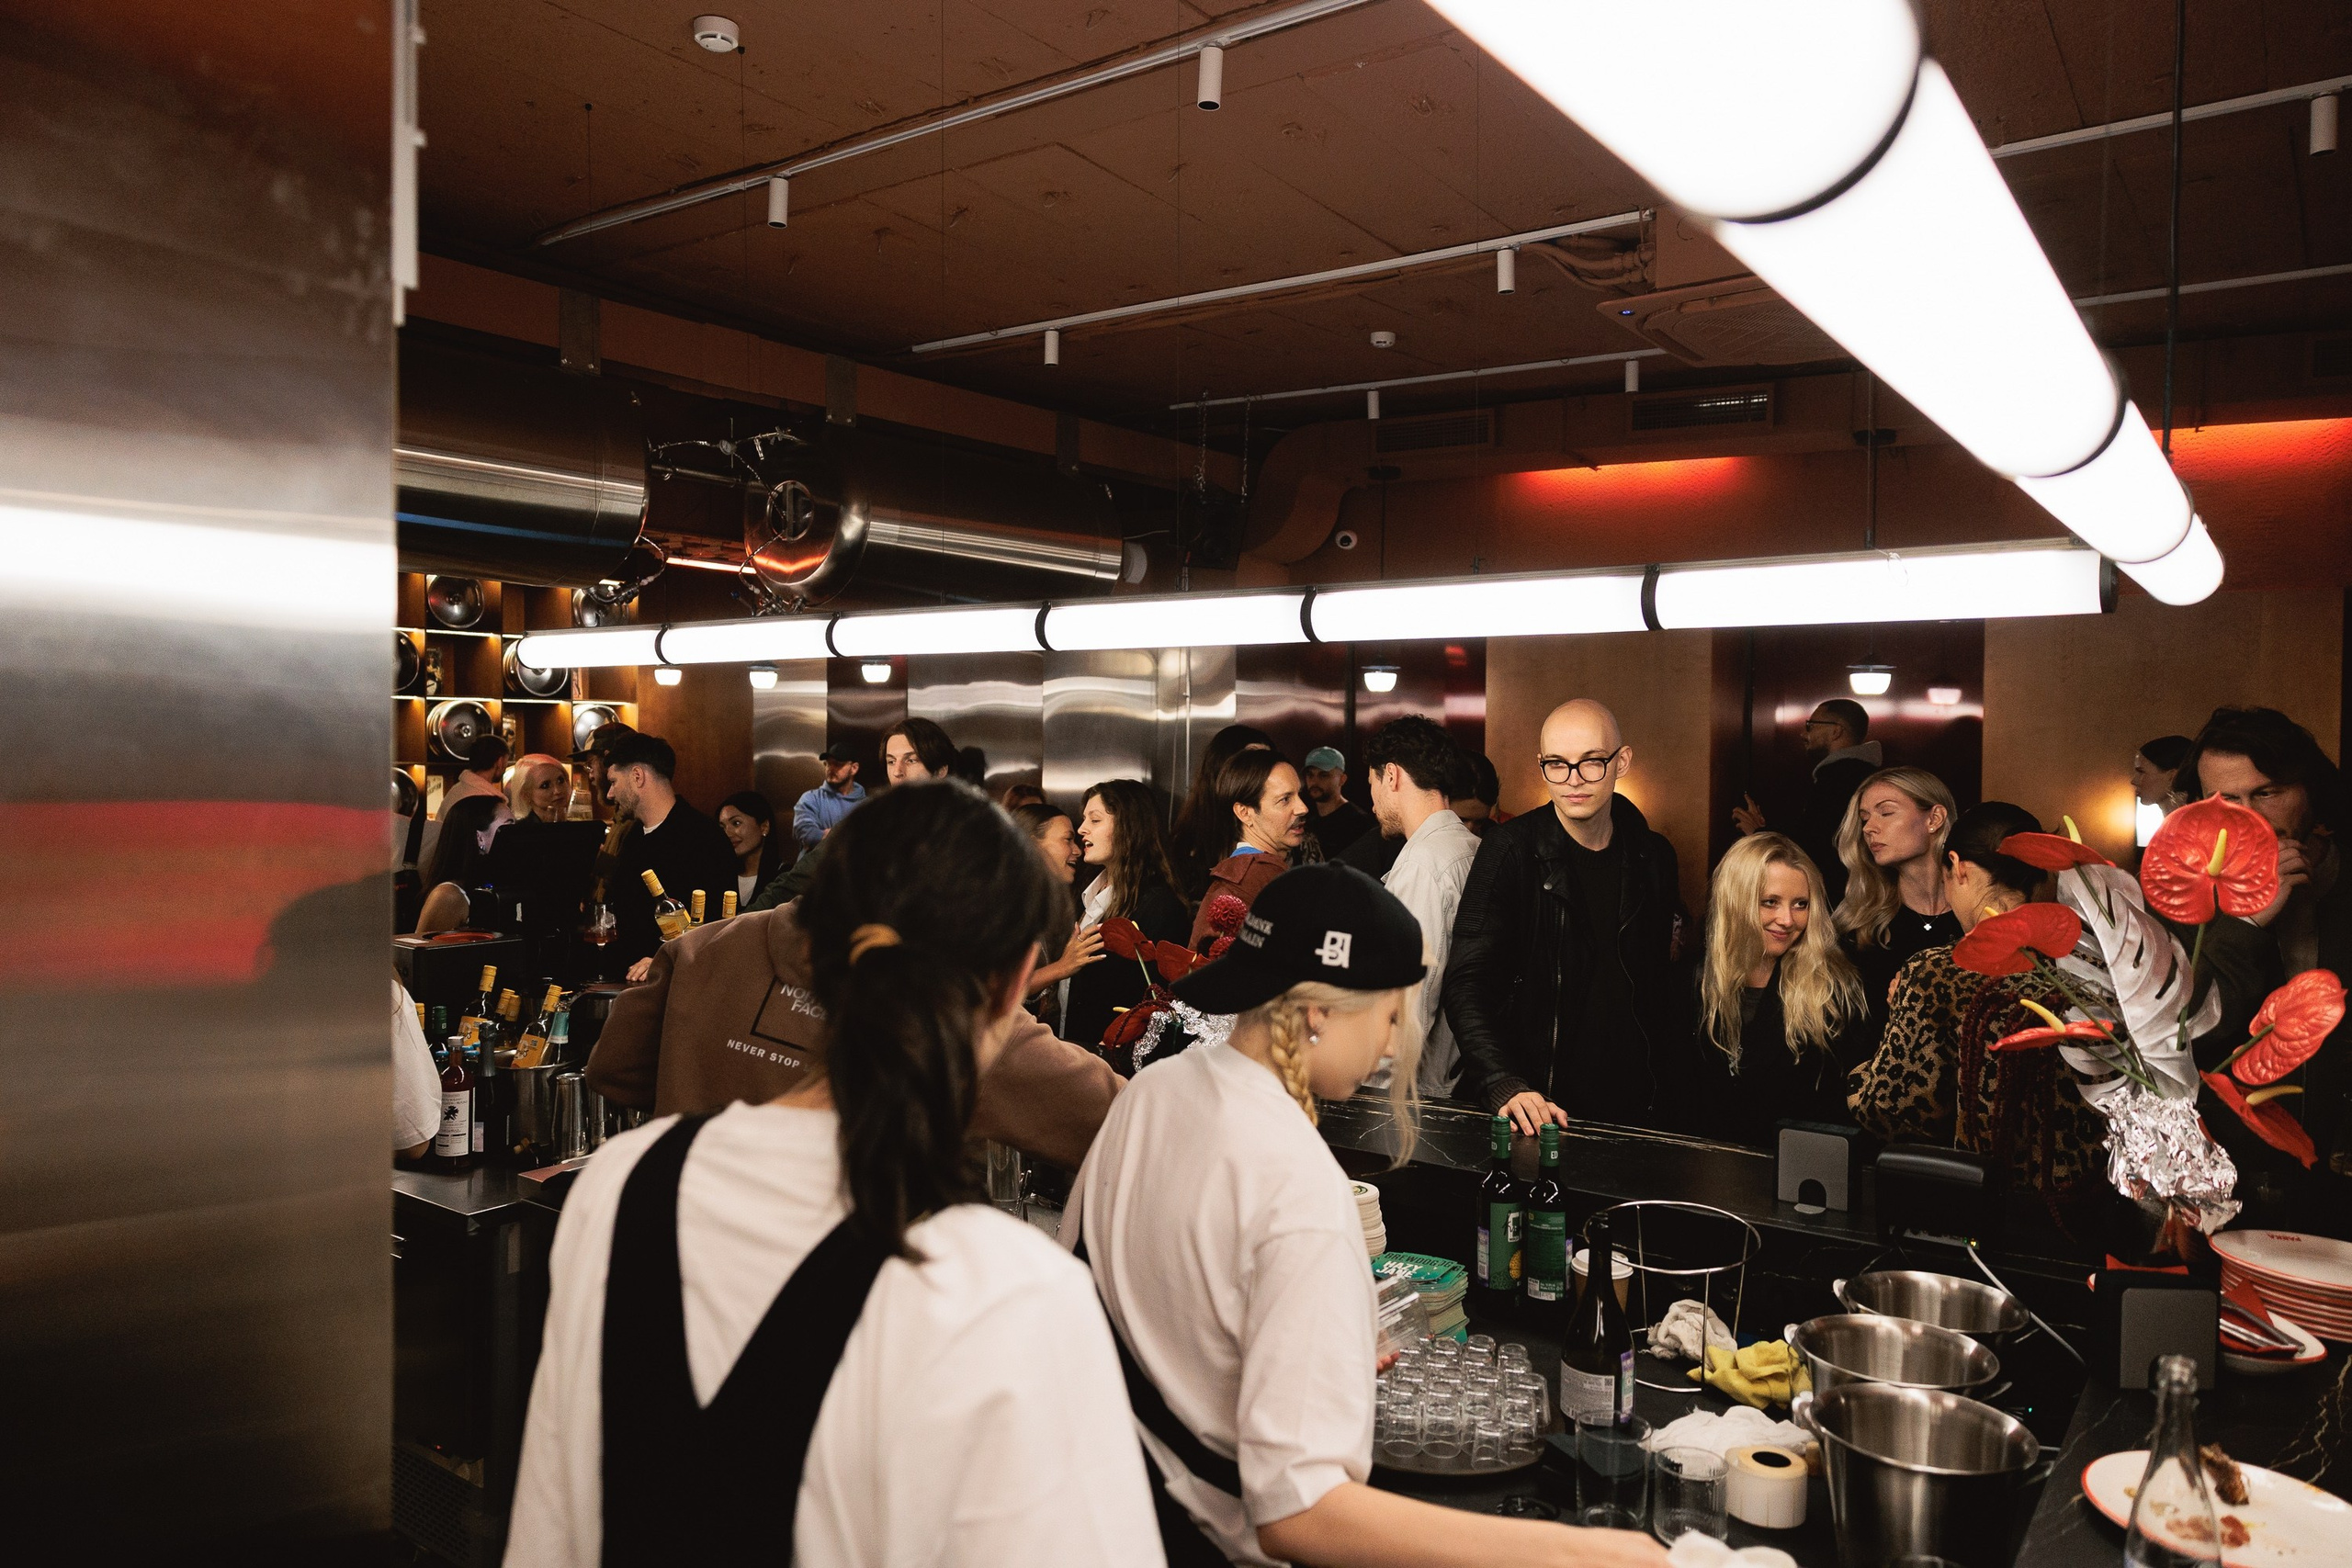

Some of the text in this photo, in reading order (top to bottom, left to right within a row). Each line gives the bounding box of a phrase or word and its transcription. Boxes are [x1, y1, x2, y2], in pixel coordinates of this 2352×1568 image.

[727, 1039, 766, 1058] NEVER
[769, 1052, 800, 1068] STOP
[1383, 1260, 1423, 1272] HAZY
[1385, 1253, 1439, 1267] BREWDOG
